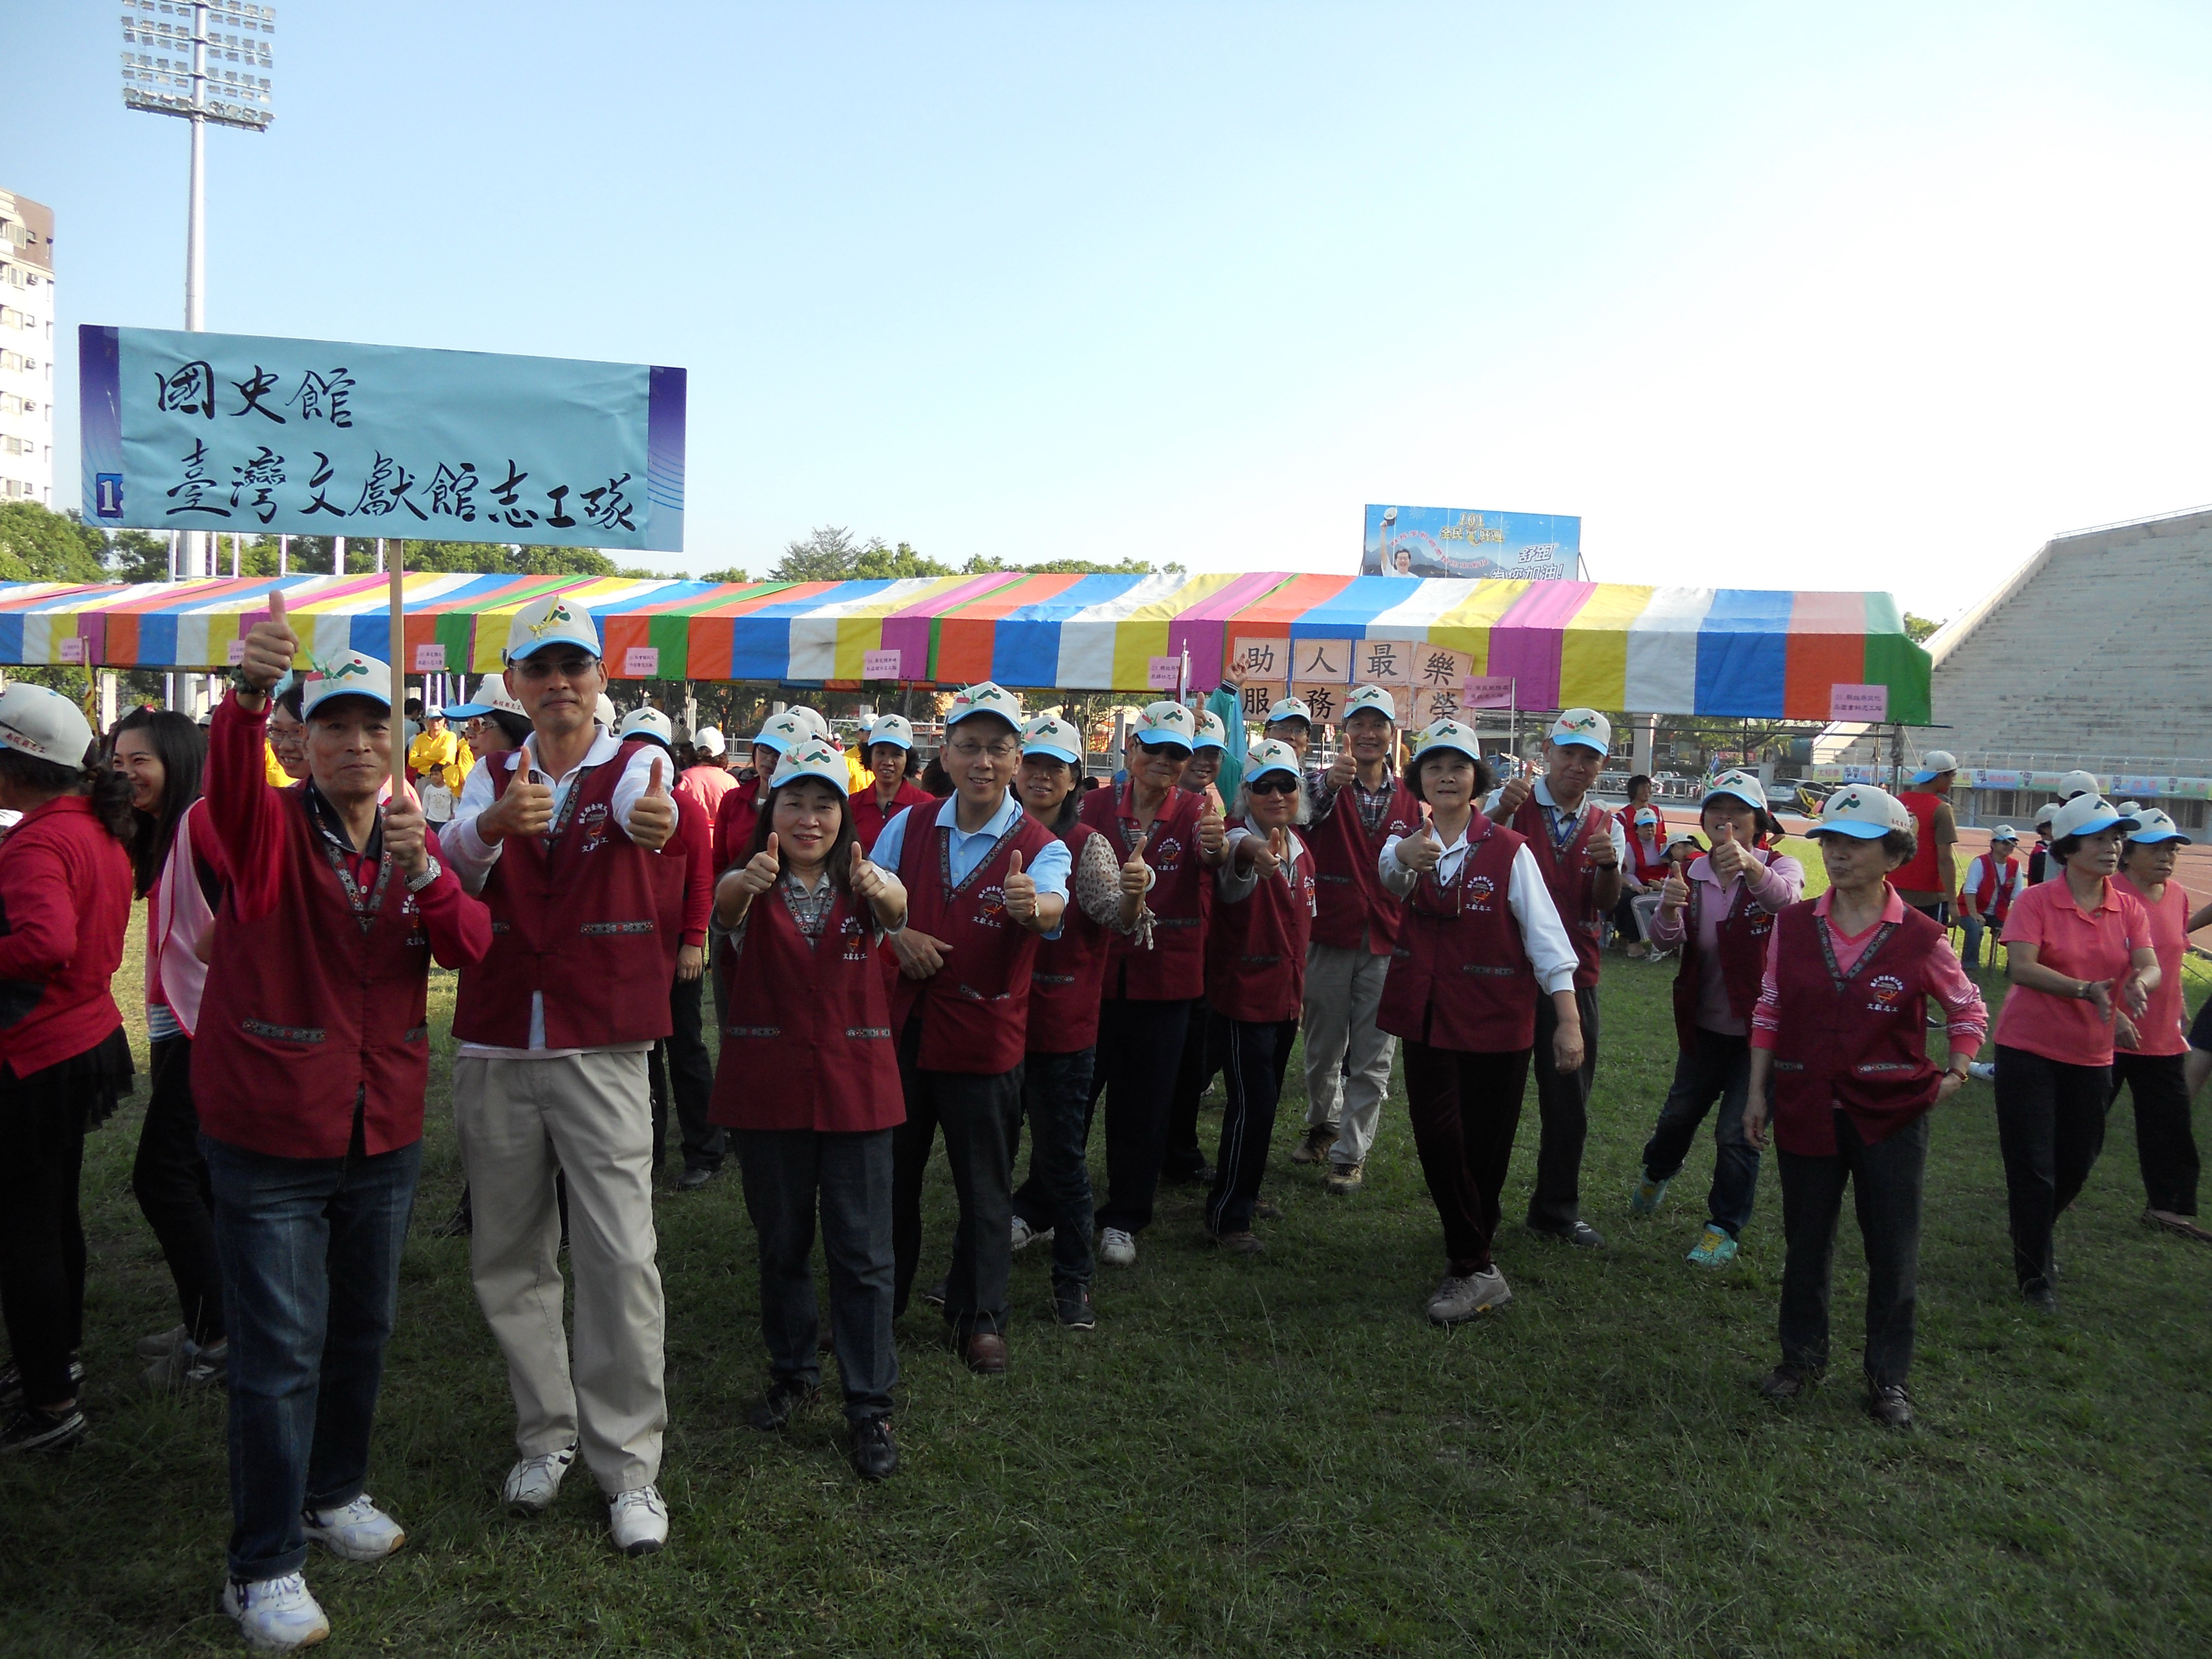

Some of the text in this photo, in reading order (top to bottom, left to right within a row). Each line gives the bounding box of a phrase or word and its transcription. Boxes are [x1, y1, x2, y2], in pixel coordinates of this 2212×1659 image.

[154, 361, 357, 428] 國史館
[100, 479, 123, 511] 1
[166, 437, 638, 532] 臺灣文獻館志工隊
[1458, 512, 1484, 527] 101
[1518, 544, 1554, 564] 舒跑
[1248, 640, 1455, 686] 助人最樂
[972, 916, 1001, 928] 文獻志工
